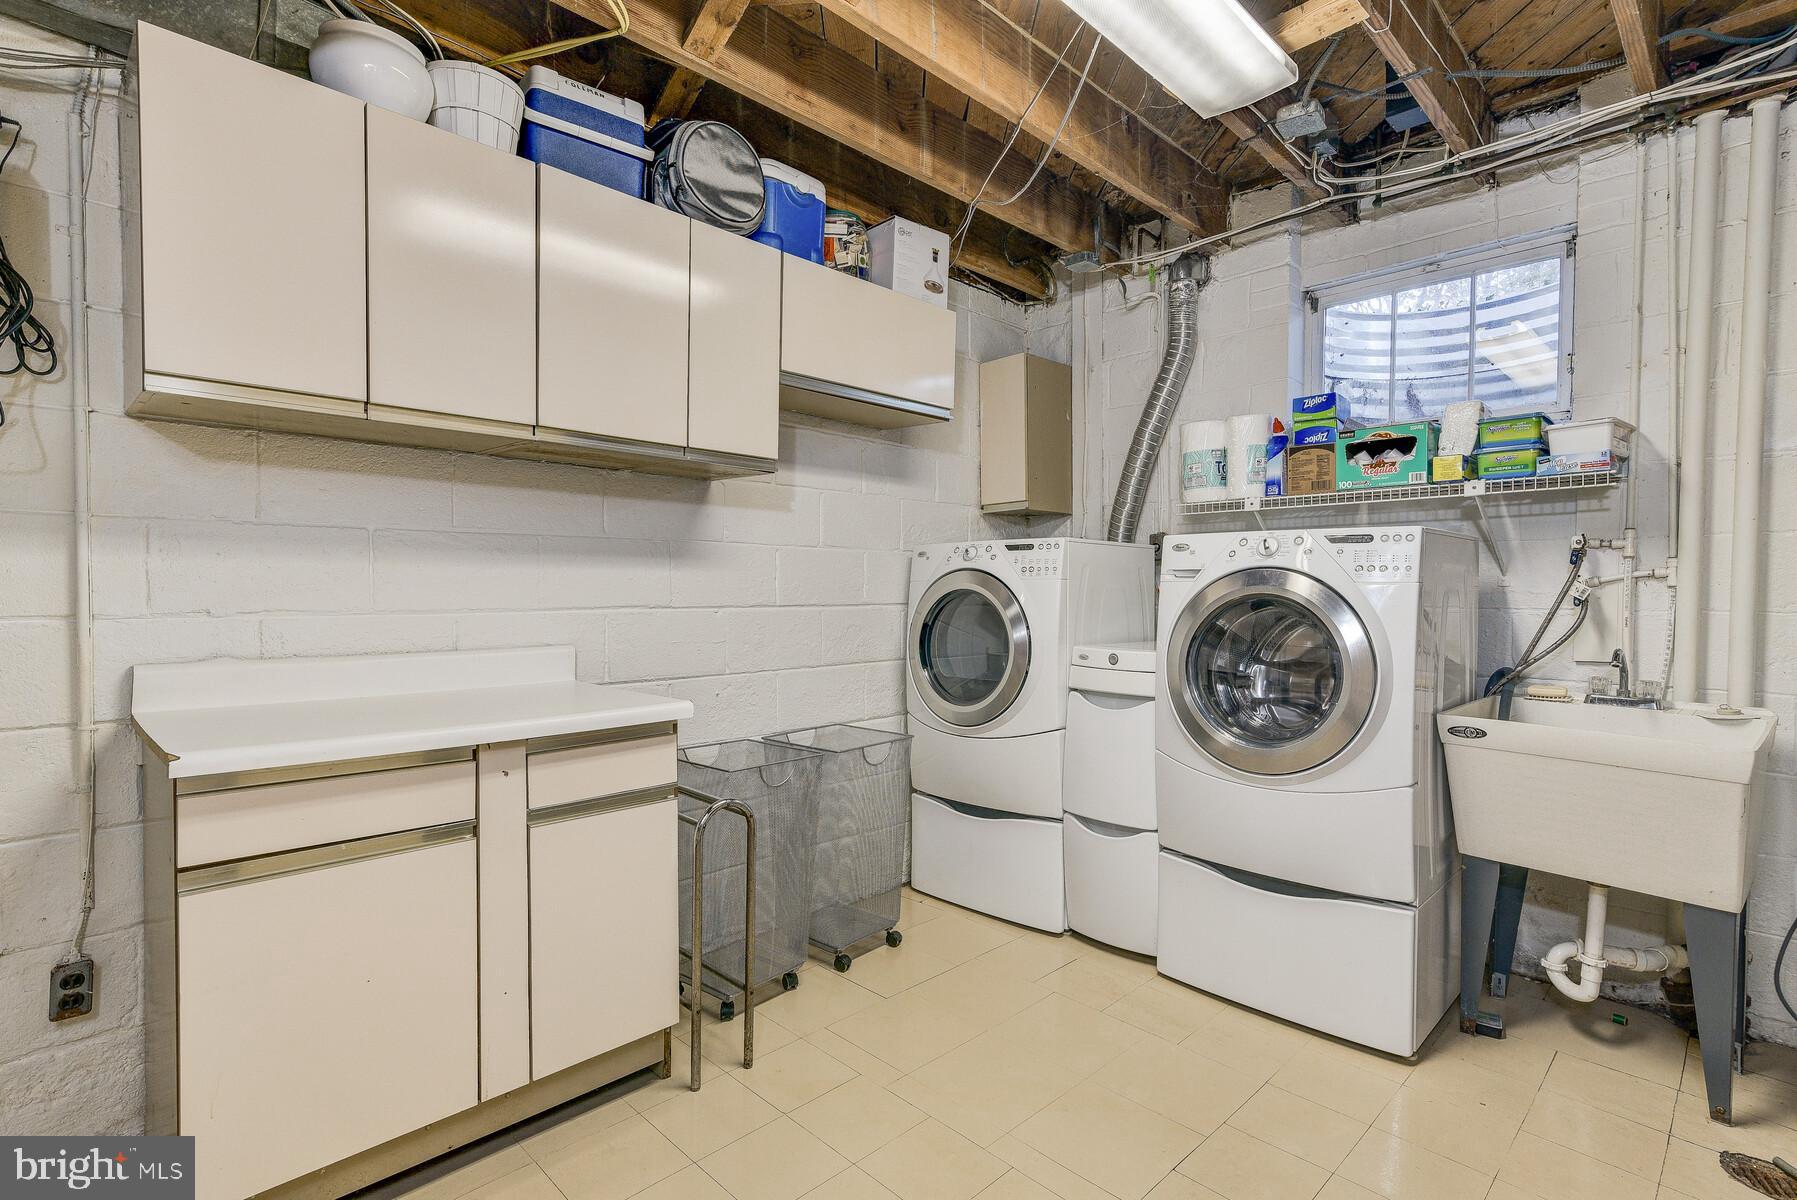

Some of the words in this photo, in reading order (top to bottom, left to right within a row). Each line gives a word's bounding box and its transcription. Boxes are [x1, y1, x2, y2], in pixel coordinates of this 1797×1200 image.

[1303, 395, 1327, 408] Ziploc
[1304, 430, 1328, 443] Ziploc
[1362, 464, 1399, 476] Regular
